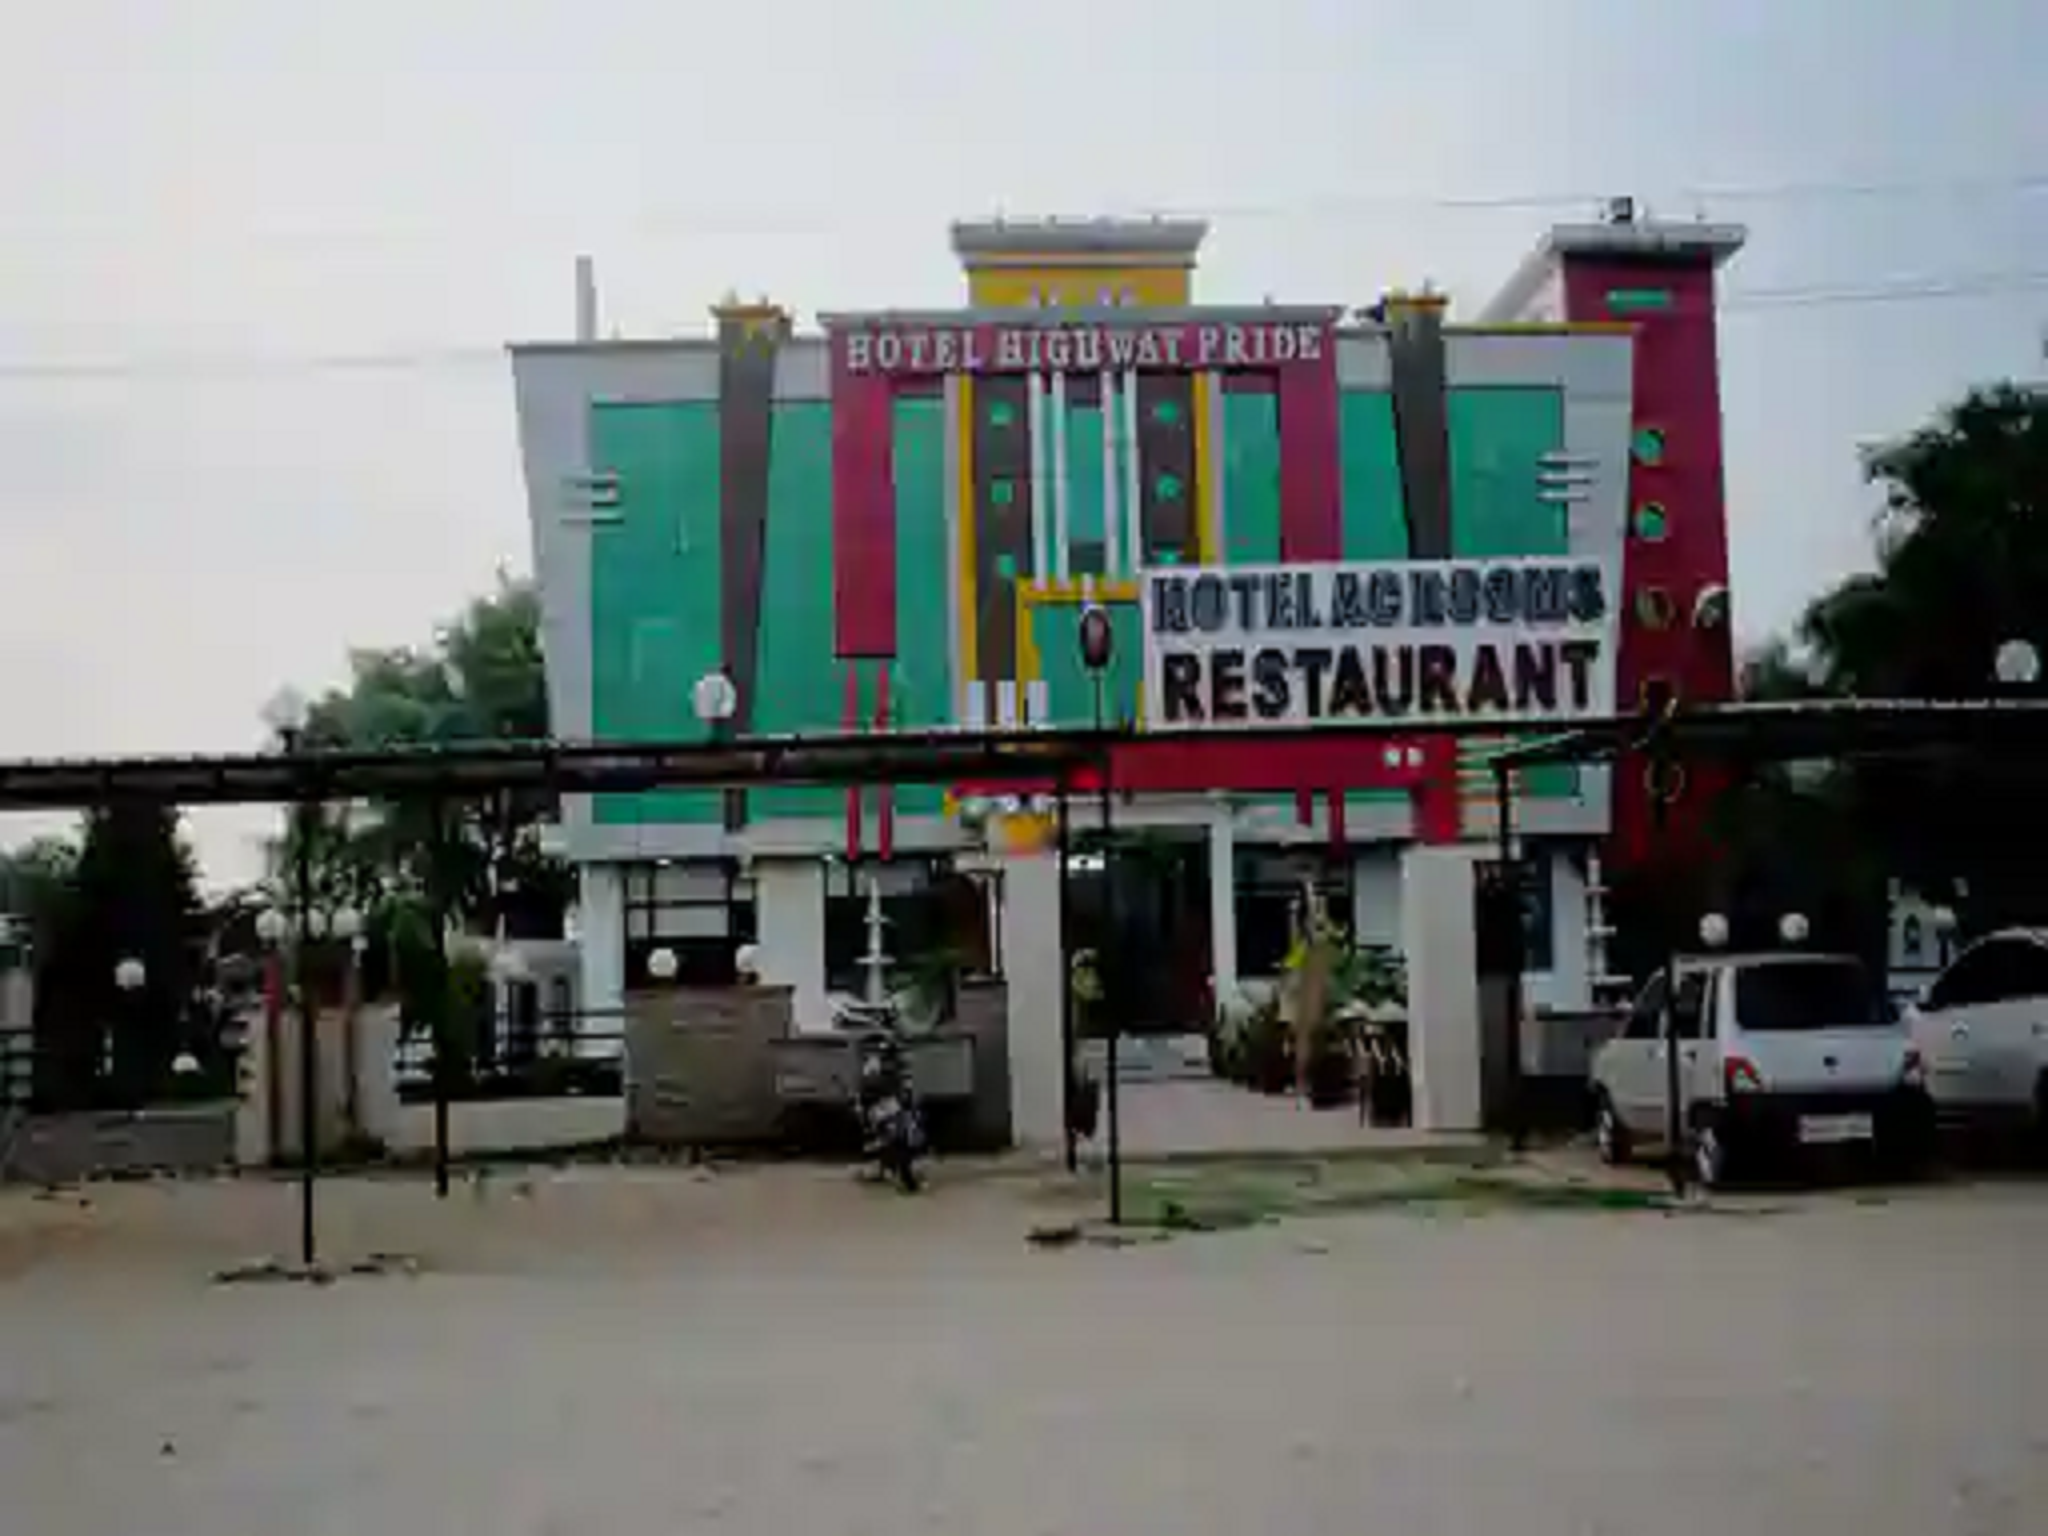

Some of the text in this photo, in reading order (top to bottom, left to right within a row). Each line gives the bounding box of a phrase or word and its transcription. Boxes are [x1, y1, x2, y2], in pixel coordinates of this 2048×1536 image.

[847, 330, 982, 369] HOTEL
[1198, 326, 1320, 363] PRIDE
[1152, 573, 1321, 632] HOTEL
[1163, 640, 1599, 719] RESTAURANT
